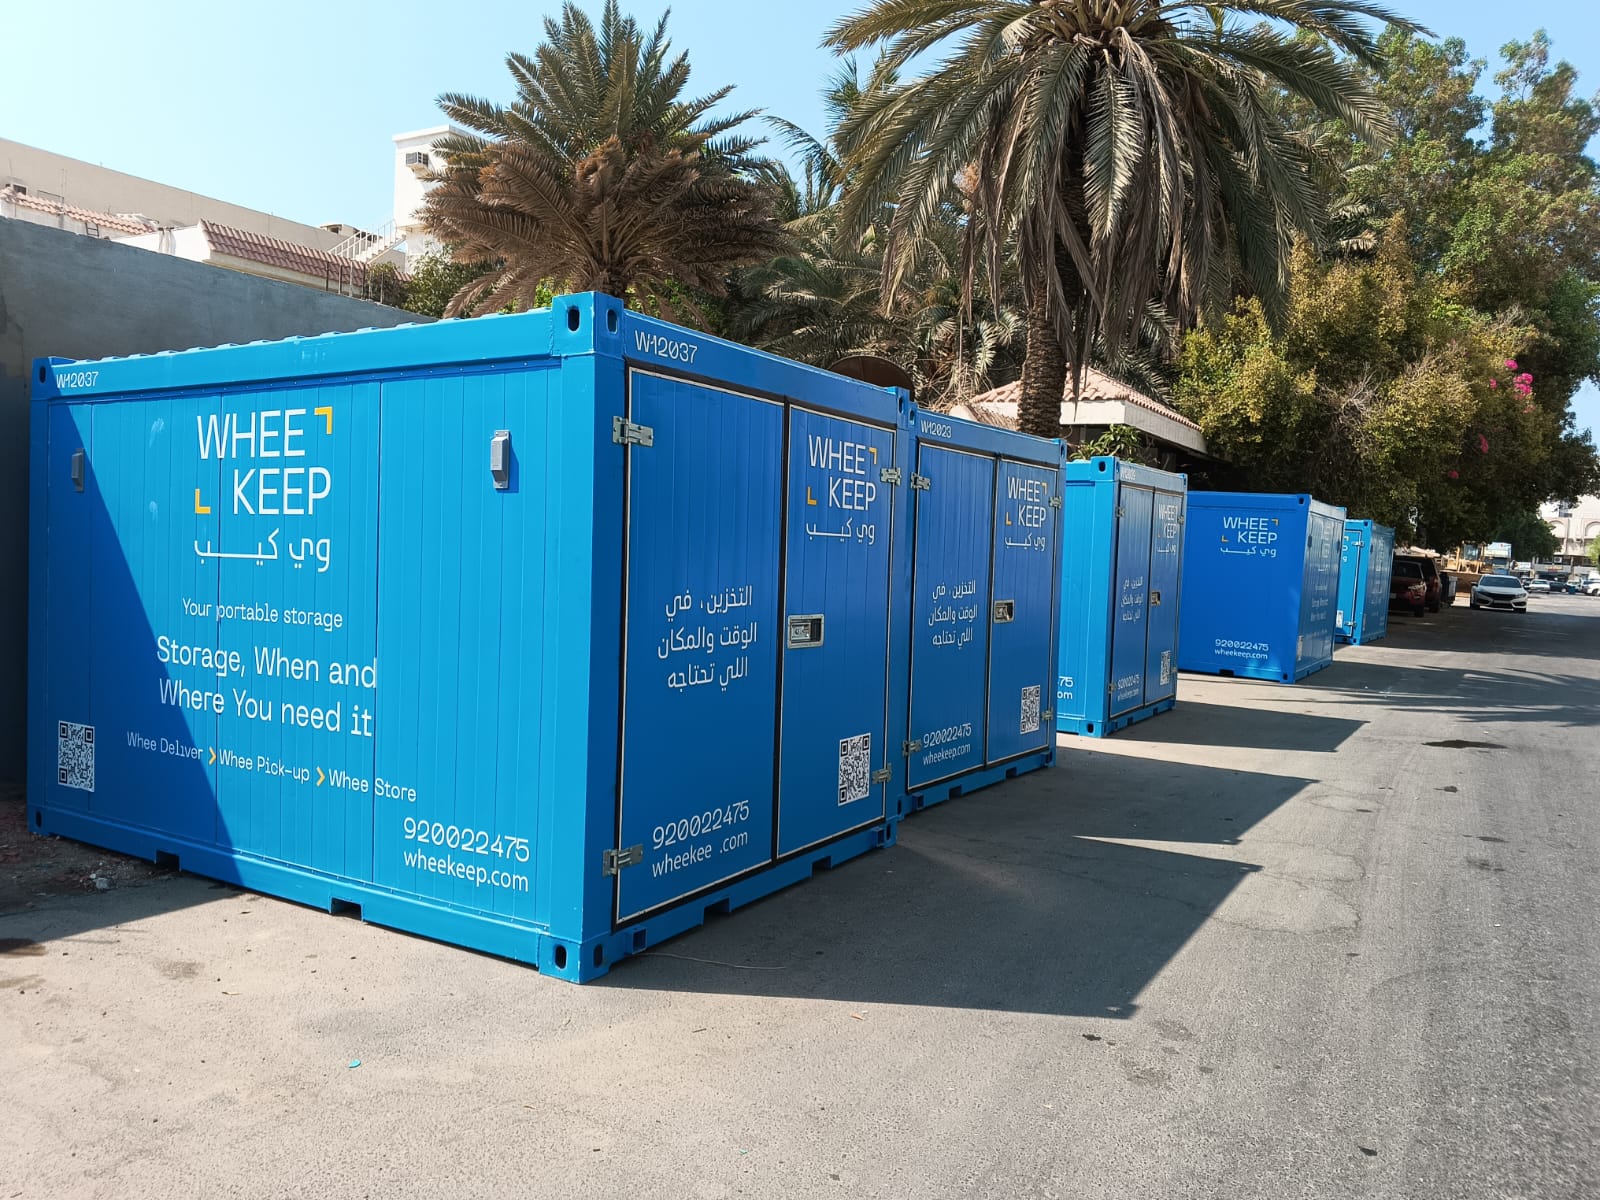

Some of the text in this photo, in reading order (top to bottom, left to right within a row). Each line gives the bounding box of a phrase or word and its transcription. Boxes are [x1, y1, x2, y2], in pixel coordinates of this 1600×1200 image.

[635, 330, 698, 364] W12037
[56, 371, 99, 389] W12037
[196, 408, 307, 459] WHEE
[808, 434, 866, 475] WHEE
[232, 467, 332, 515] KEEP
[828, 476, 877, 511] KEEP
[1007, 476, 1041, 502] WHEE
[1017, 504, 1047, 528] KEEP
[1223, 516, 1269, 531] WHEE
[856, 523, 876, 545] وي
[1237, 531, 1278, 544] KEEP
[288, 538, 331, 573] وي
[181, 597, 344, 632] Your portable storage
[665, 589, 693, 623] في
[657, 622, 757, 660] الوقت والمكان
[1214, 647, 1269, 660] wheekeep.com
[1215, 638, 1270, 652] 920022475
[156, 635, 378, 690] Storage, When and
[667, 655, 749, 693] اللي تحتاجه
[159, 678, 373, 738] Where You need it
[923, 722, 973, 749] 920022475
[126, 731, 417, 803] Whee Deliver Whee Pick-up Whee Store
[922, 743, 971, 766] wheekeep.com
[403, 816, 530, 862] 920022475
[652, 799, 750, 851] 920022475
[403, 848, 529, 892] wheekeep.com
